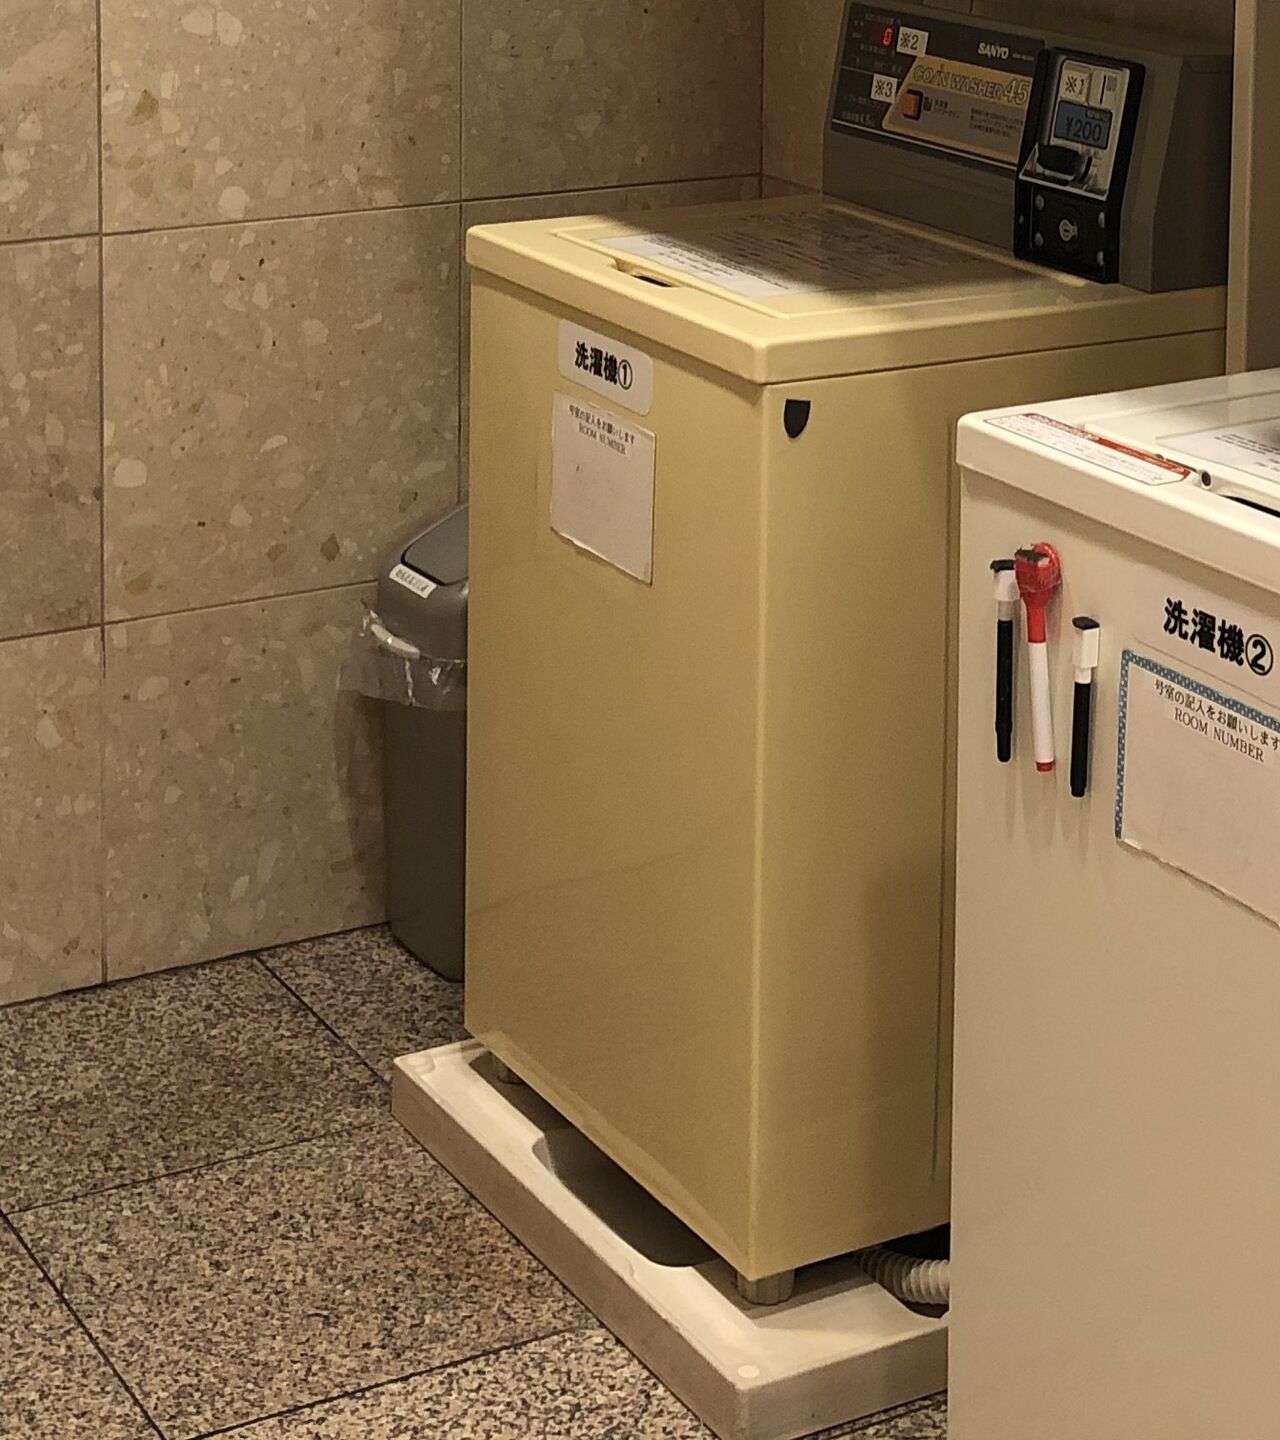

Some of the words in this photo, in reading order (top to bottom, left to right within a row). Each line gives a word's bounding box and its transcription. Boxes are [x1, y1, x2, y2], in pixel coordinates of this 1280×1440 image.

[977, 41, 1010, 60] SANYO
[950, 72, 1004, 101] WASHER
[1004, 78, 1032, 107] 45
[1065, 115, 1102, 143] ¥200
[574, 340, 634, 391] 洗濯機①
[578, 422, 599, 442] ROOM
[599, 431, 627, 456] NUMBER
[1162, 596, 1275, 677] 洗濯機②
[1174, 707, 1209, 737] ROOM
[1213, 726, 1265, 764] NUMBER
